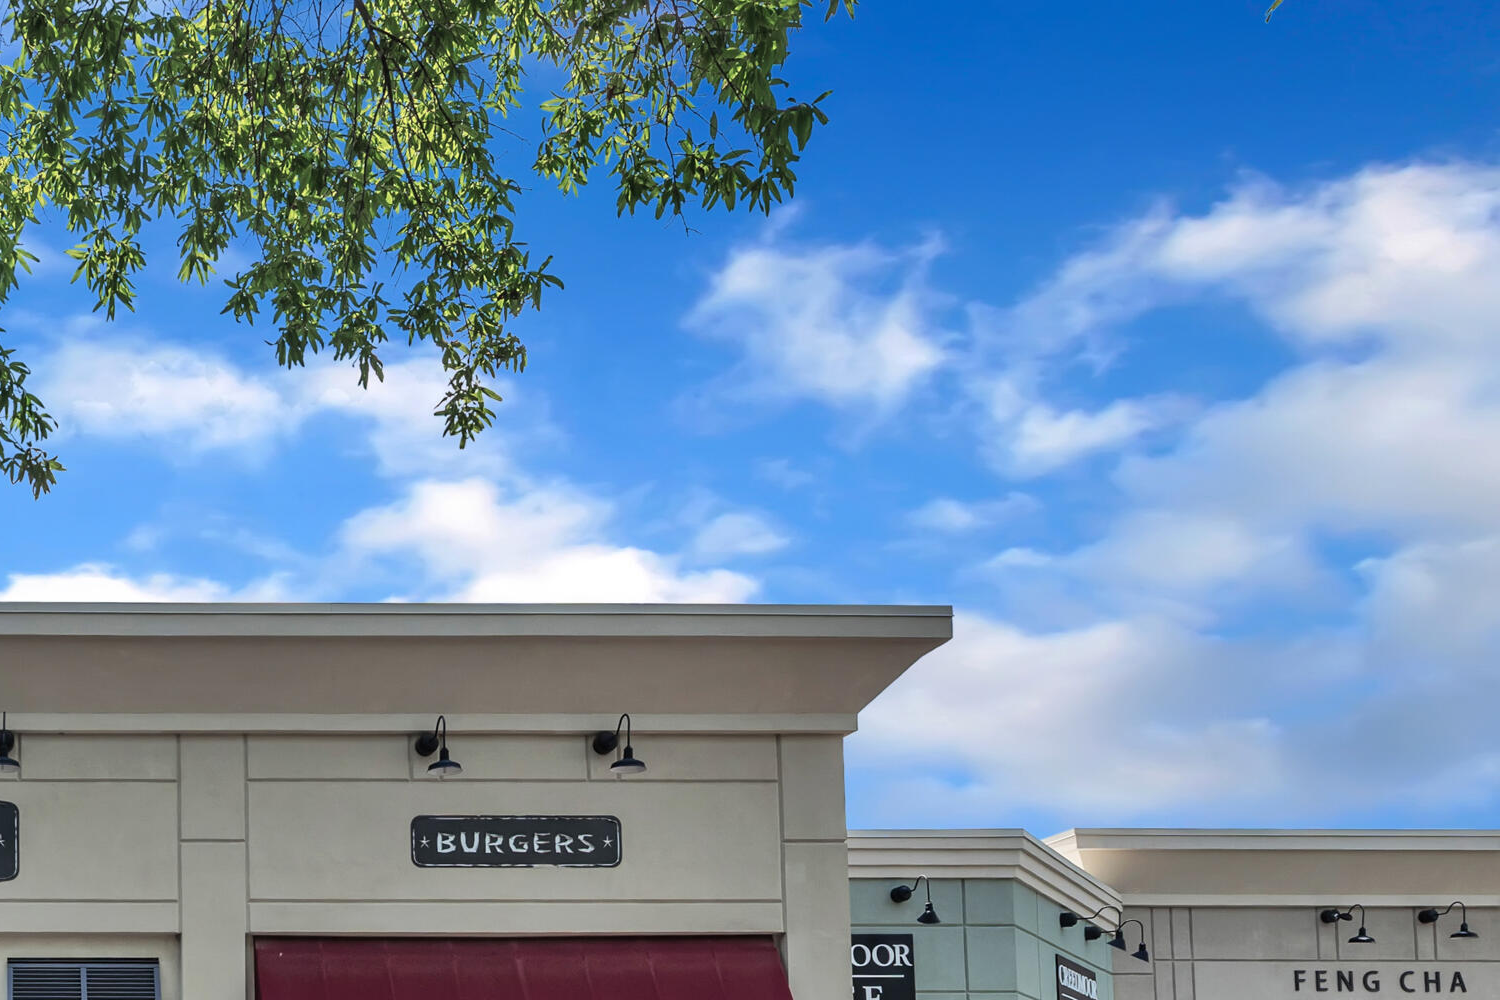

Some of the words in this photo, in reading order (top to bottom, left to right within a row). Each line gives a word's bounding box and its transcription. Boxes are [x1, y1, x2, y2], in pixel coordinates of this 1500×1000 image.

[436, 832, 595, 854] BURGERS
[1058, 964, 1098, 1000] CREEDMOOR
[1293, 970, 1381, 993] FENG
[1399, 971, 1467, 993] CHA
